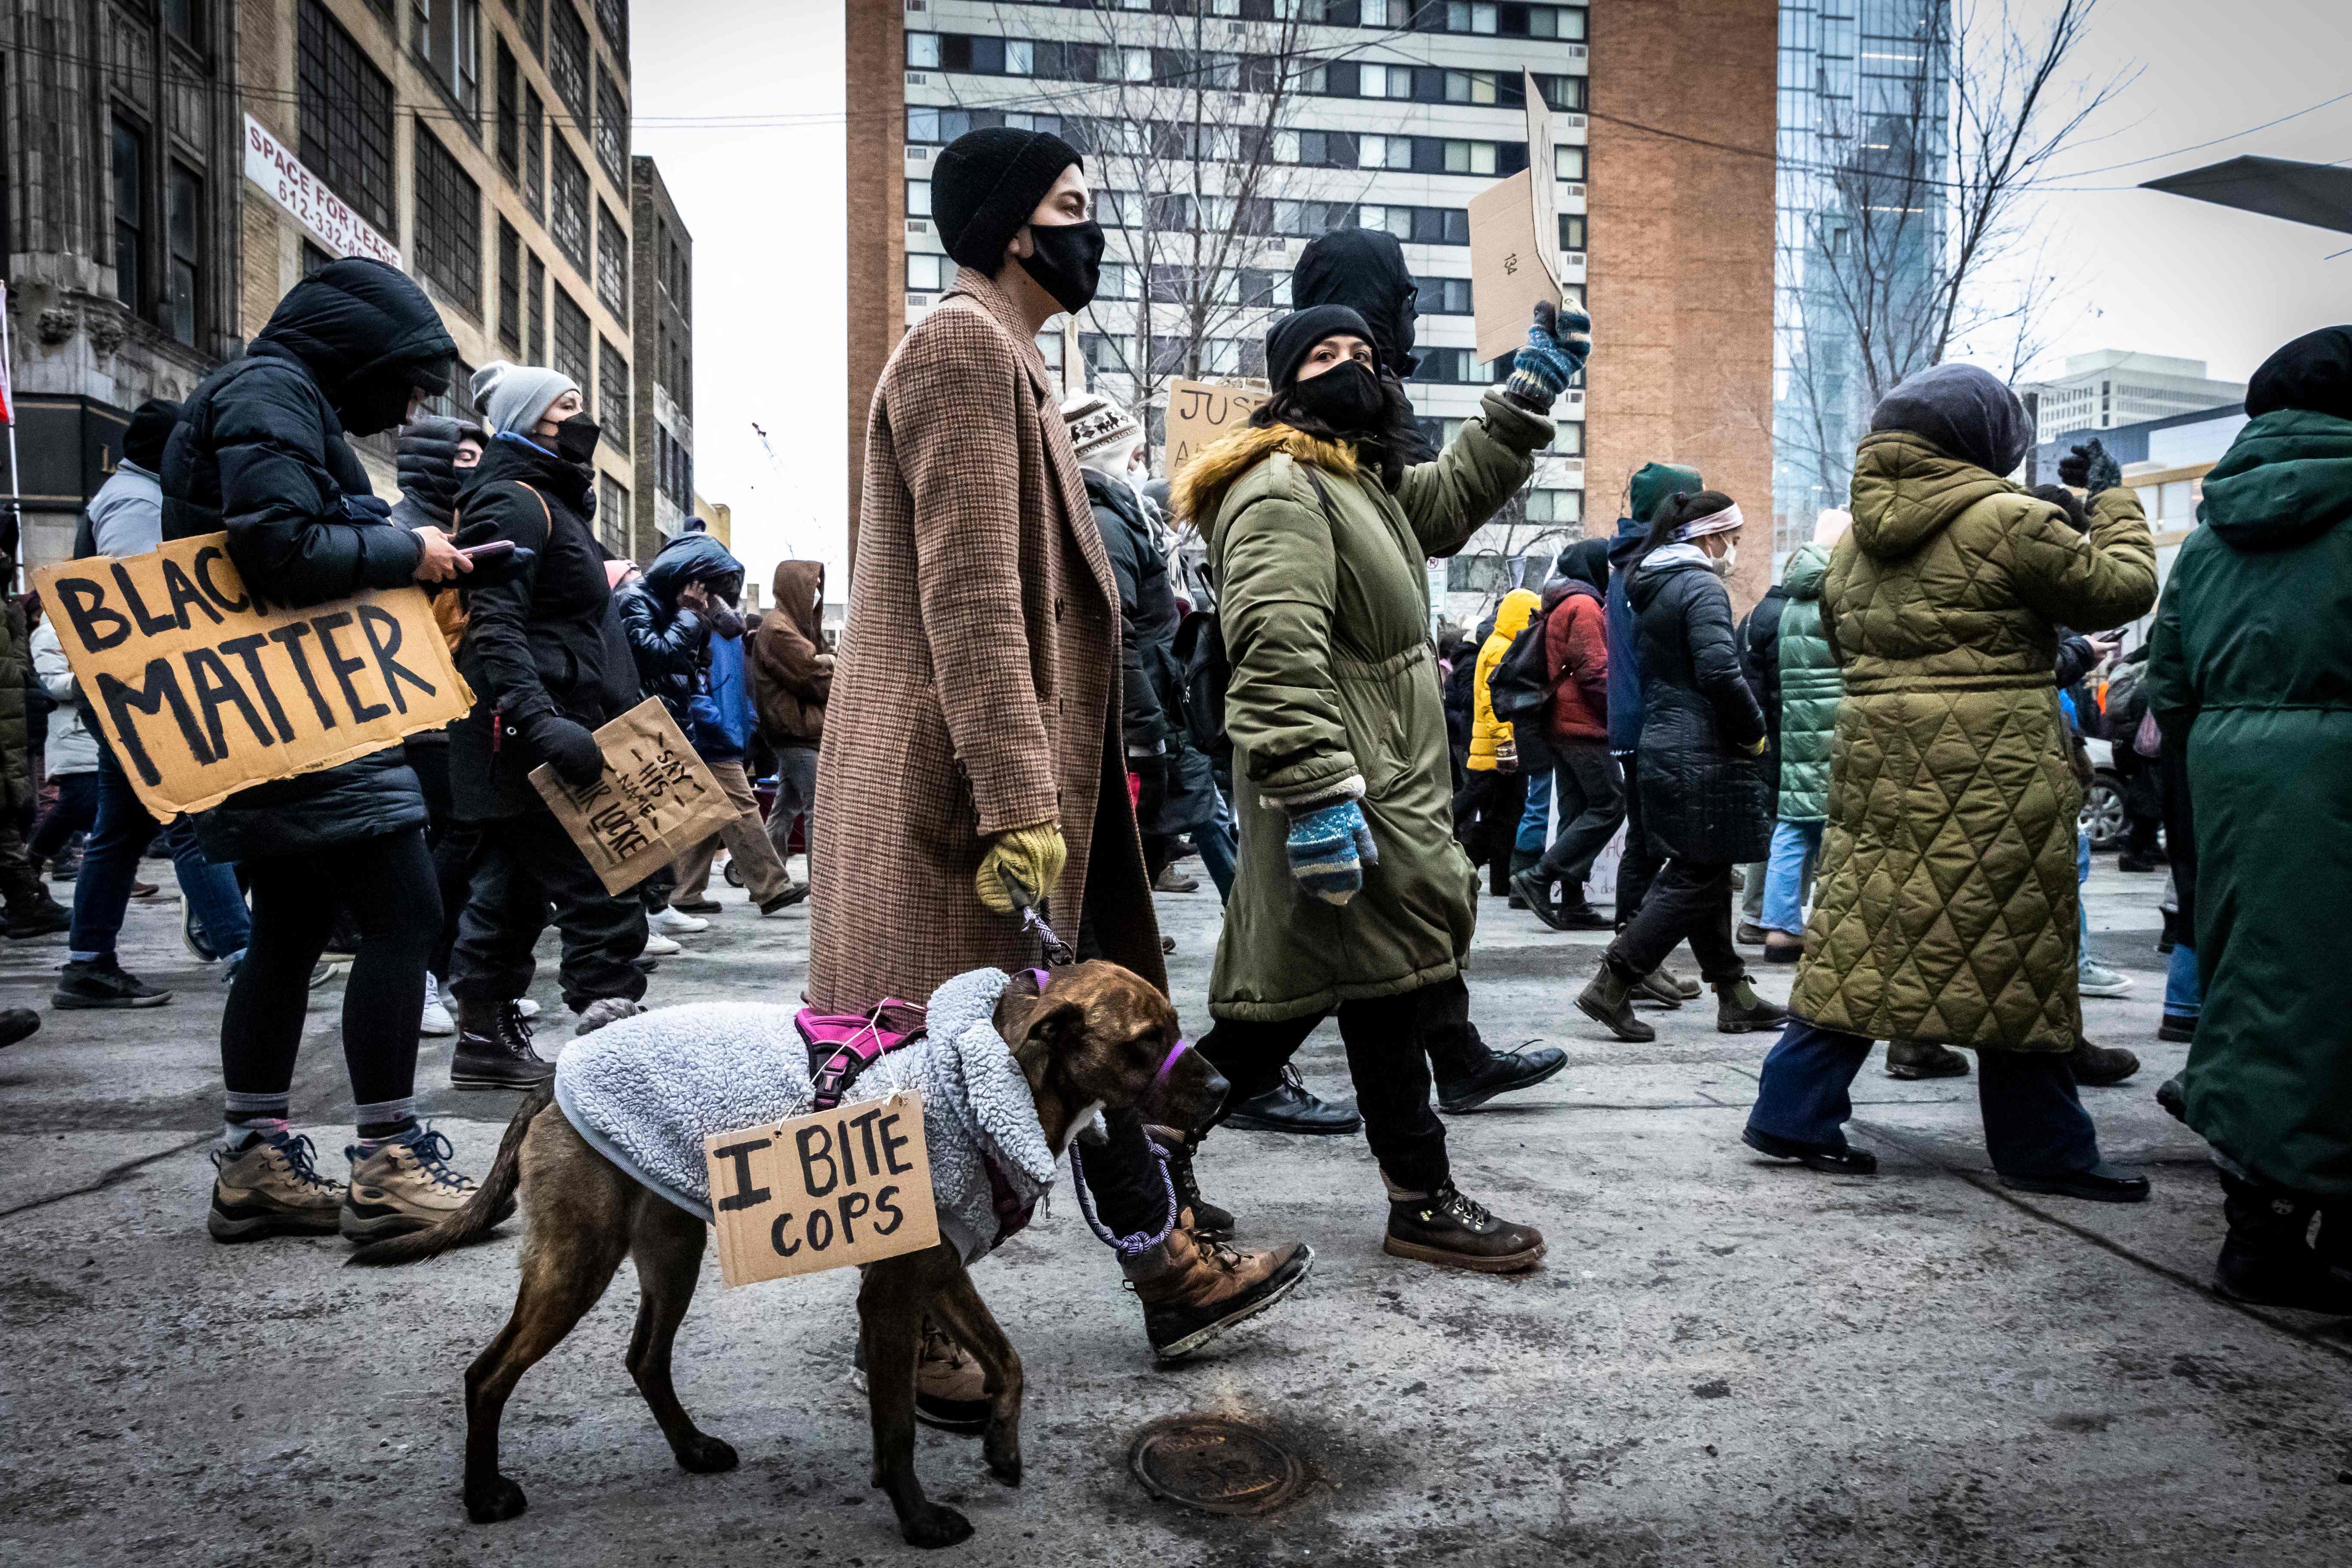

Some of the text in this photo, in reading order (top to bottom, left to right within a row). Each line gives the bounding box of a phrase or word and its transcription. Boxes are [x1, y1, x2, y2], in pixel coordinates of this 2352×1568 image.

[251, 127, 398, 266] SPACE FOR LEASE
[1504, 253, 1518, 276] 134
[1180, 389, 1263, 425] JUS
[55, 545, 268, 653] BLAC
[95, 605, 437, 787] MATTER
[616, 773, 656, 818] NAME
[639, 762, 668, 797] HIS
[657, 749, 693, 784] SAY
[590, 801, 649, 860] LOCKE
[713, 1108, 913, 1212] I BITE
[771, 1185, 904, 1257] COPS
